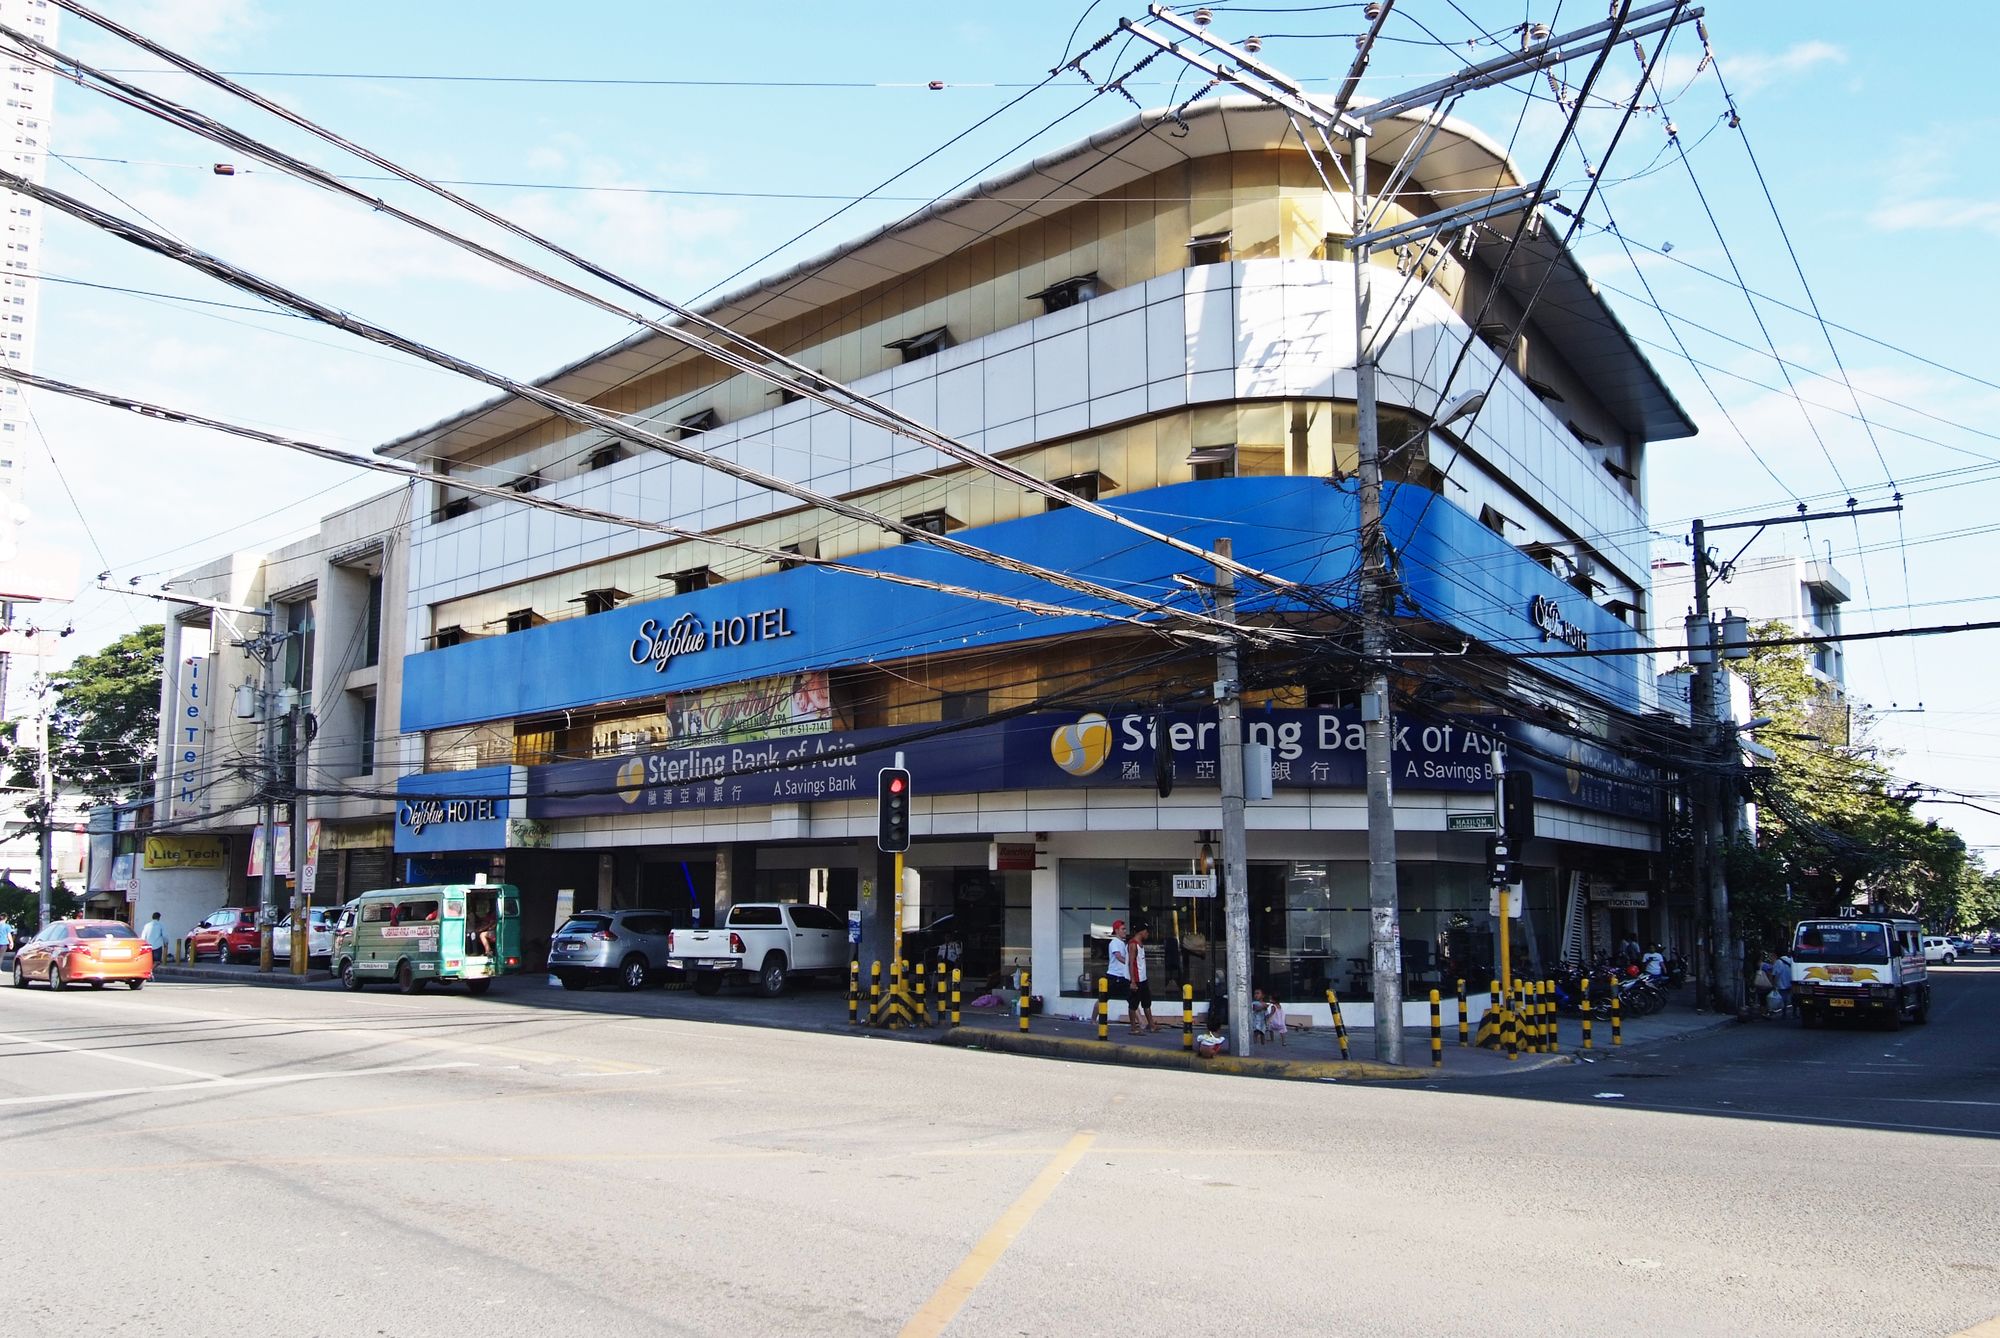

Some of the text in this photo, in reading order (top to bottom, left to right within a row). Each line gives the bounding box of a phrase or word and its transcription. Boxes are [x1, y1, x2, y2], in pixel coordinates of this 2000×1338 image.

[629, 608, 792, 673] Skyblue HOTEL
[797, 721, 828, 734] 511-7141
[1122, 713, 1303, 760] Sterng
[1318, 715, 1412, 752] Bak
[648, 750, 726, 786] Sterling
[732, 744, 780, 774] Bank
[1405, 760, 1419, 778] A
[1424, 760, 1482, 783] Savings
[774, 775, 856, 797] A Savings Bank
[448, 800, 496, 823] HOTEL
[153, 849, 220, 860] Lite Tech
